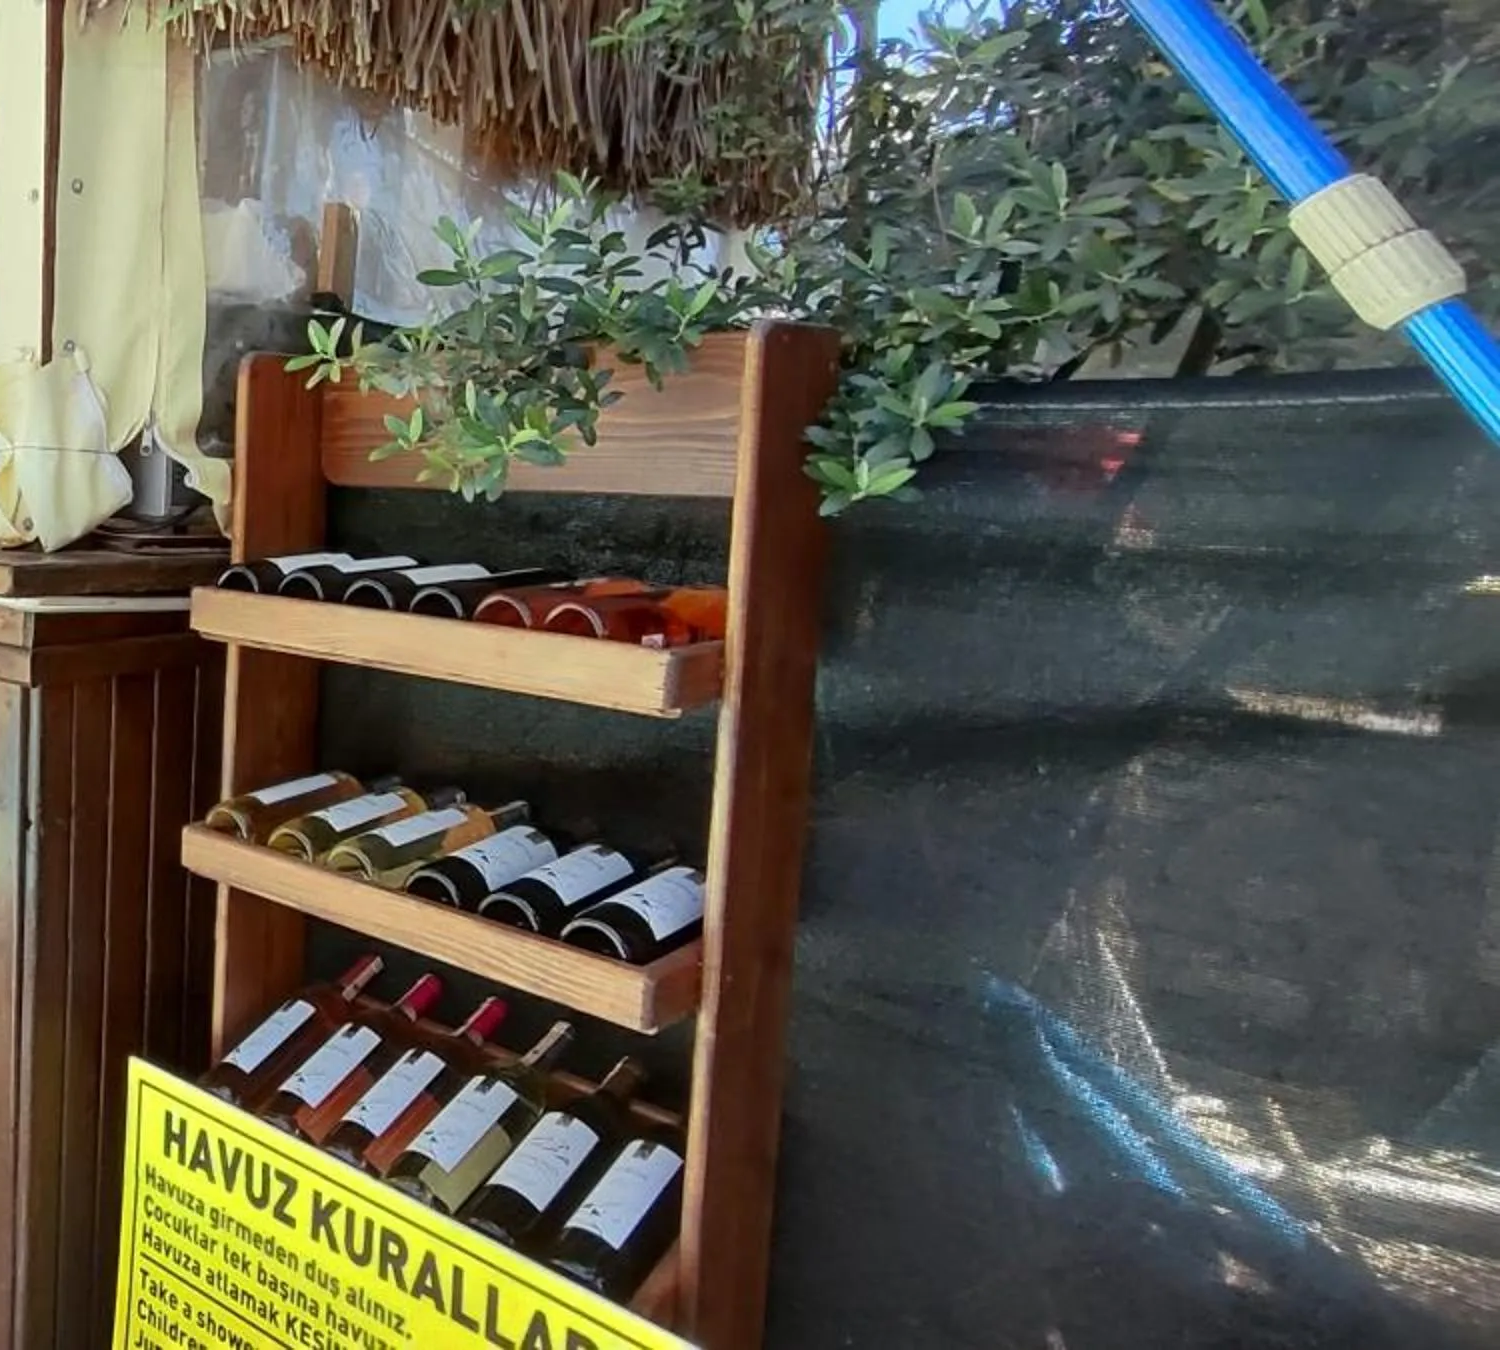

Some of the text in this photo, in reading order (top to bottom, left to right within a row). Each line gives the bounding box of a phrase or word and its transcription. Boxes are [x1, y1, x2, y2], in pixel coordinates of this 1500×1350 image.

[163, 1109, 299, 1230] HAVUZ
[140, 1268, 179, 1311] Take
[182, 1301, 193, 1320] a
[141, 1222, 201, 1278] Havuza
[206, 1269, 279, 1329] atlamak
[145, 1163, 412, 1341] Havuza girmeden duş alınız.
[224, 1243, 250, 1279] tek
[257, 1261, 319, 1319] başına
[325, 1303, 397, 1350] havuz
